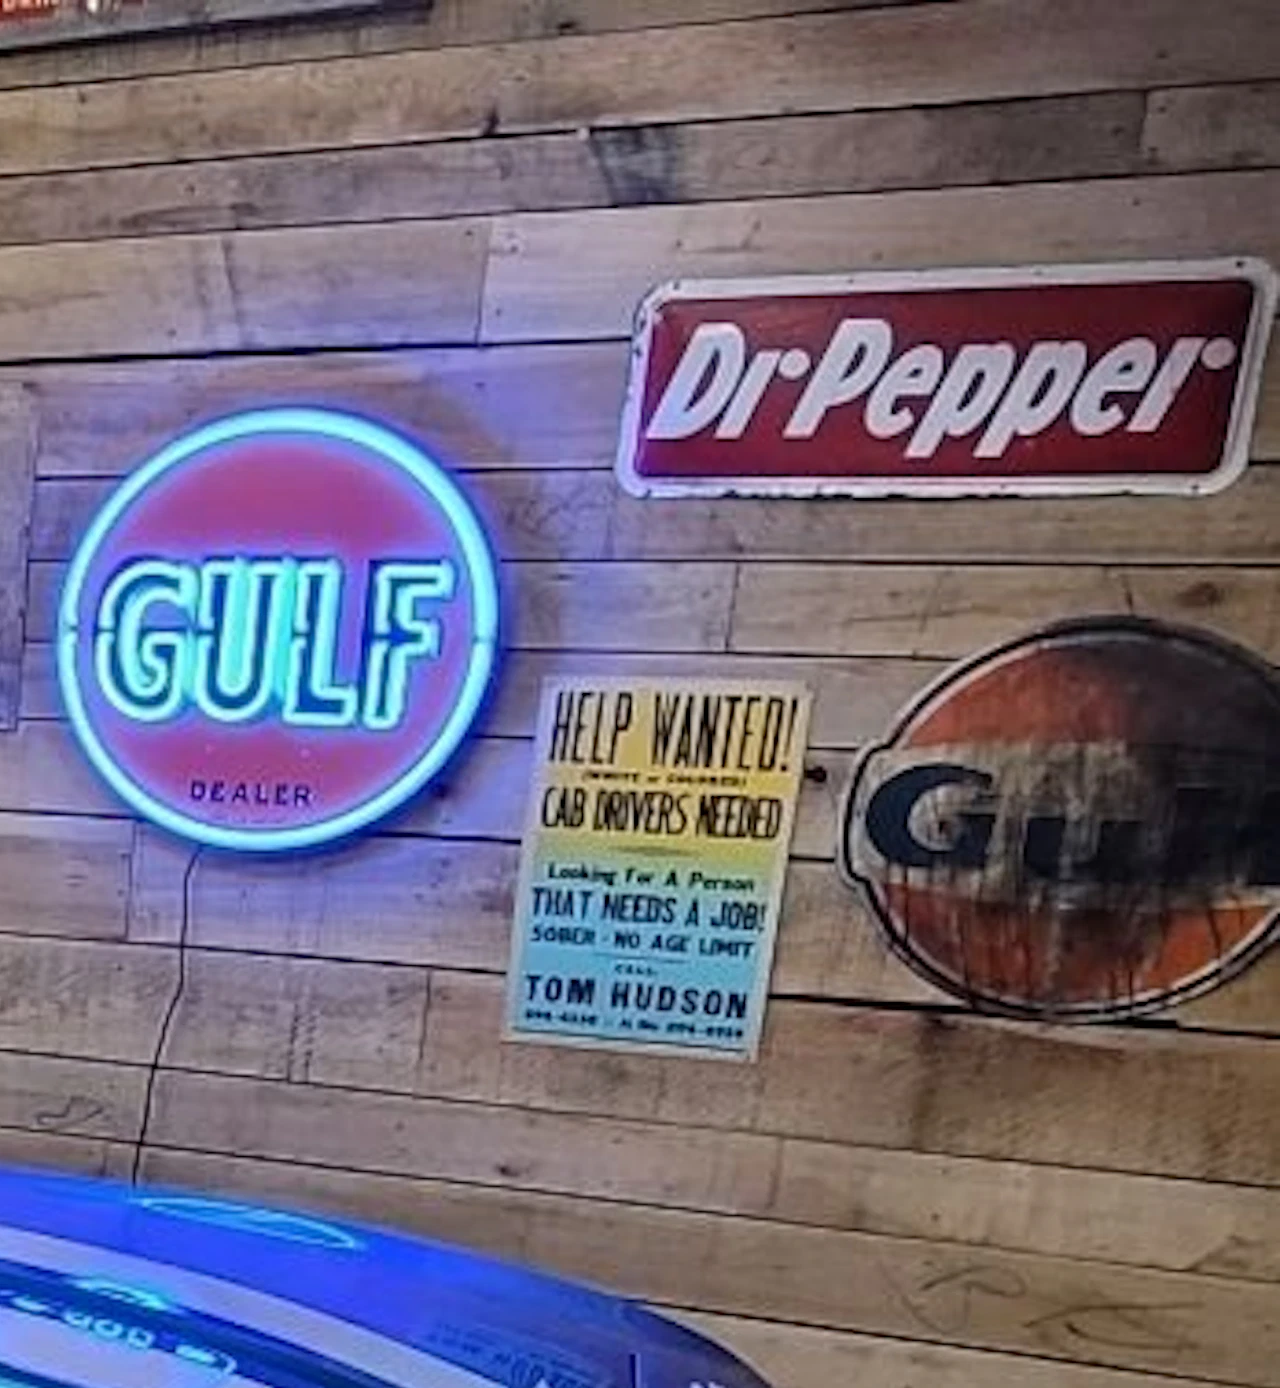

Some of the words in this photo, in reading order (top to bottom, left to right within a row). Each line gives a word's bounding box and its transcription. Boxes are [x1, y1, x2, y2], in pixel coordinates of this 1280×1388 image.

[784, 317, 1238, 459] Pepper
[95, 556, 455, 730] GULF
[549, 691, 633, 764] HELP
[652, 693, 798, 772] WANTED!
[190, 779, 313, 807] DEALER
[542, 787, 585, 828] CAB
[593, 789, 688, 835] DRIVERS
[695, 795, 781, 839] NEEDED
[548, 862, 618, 886] Looking
[663, 870, 678, 887] A
[690, 872, 755, 891] Person
[531, 887, 594, 918] THAT
[600, 893, 677, 924] NEEDS
[685, 899, 700, 927] A
[710, 902, 767, 934] JOB!
[613, 930, 641, 949] NO
[649, 933, 689, 953] AGE
[698, 937, 756, 959] LIMIT
[526, 973, 596, 1004] TOM
[610, 979, 748, 1019] HUDSON
